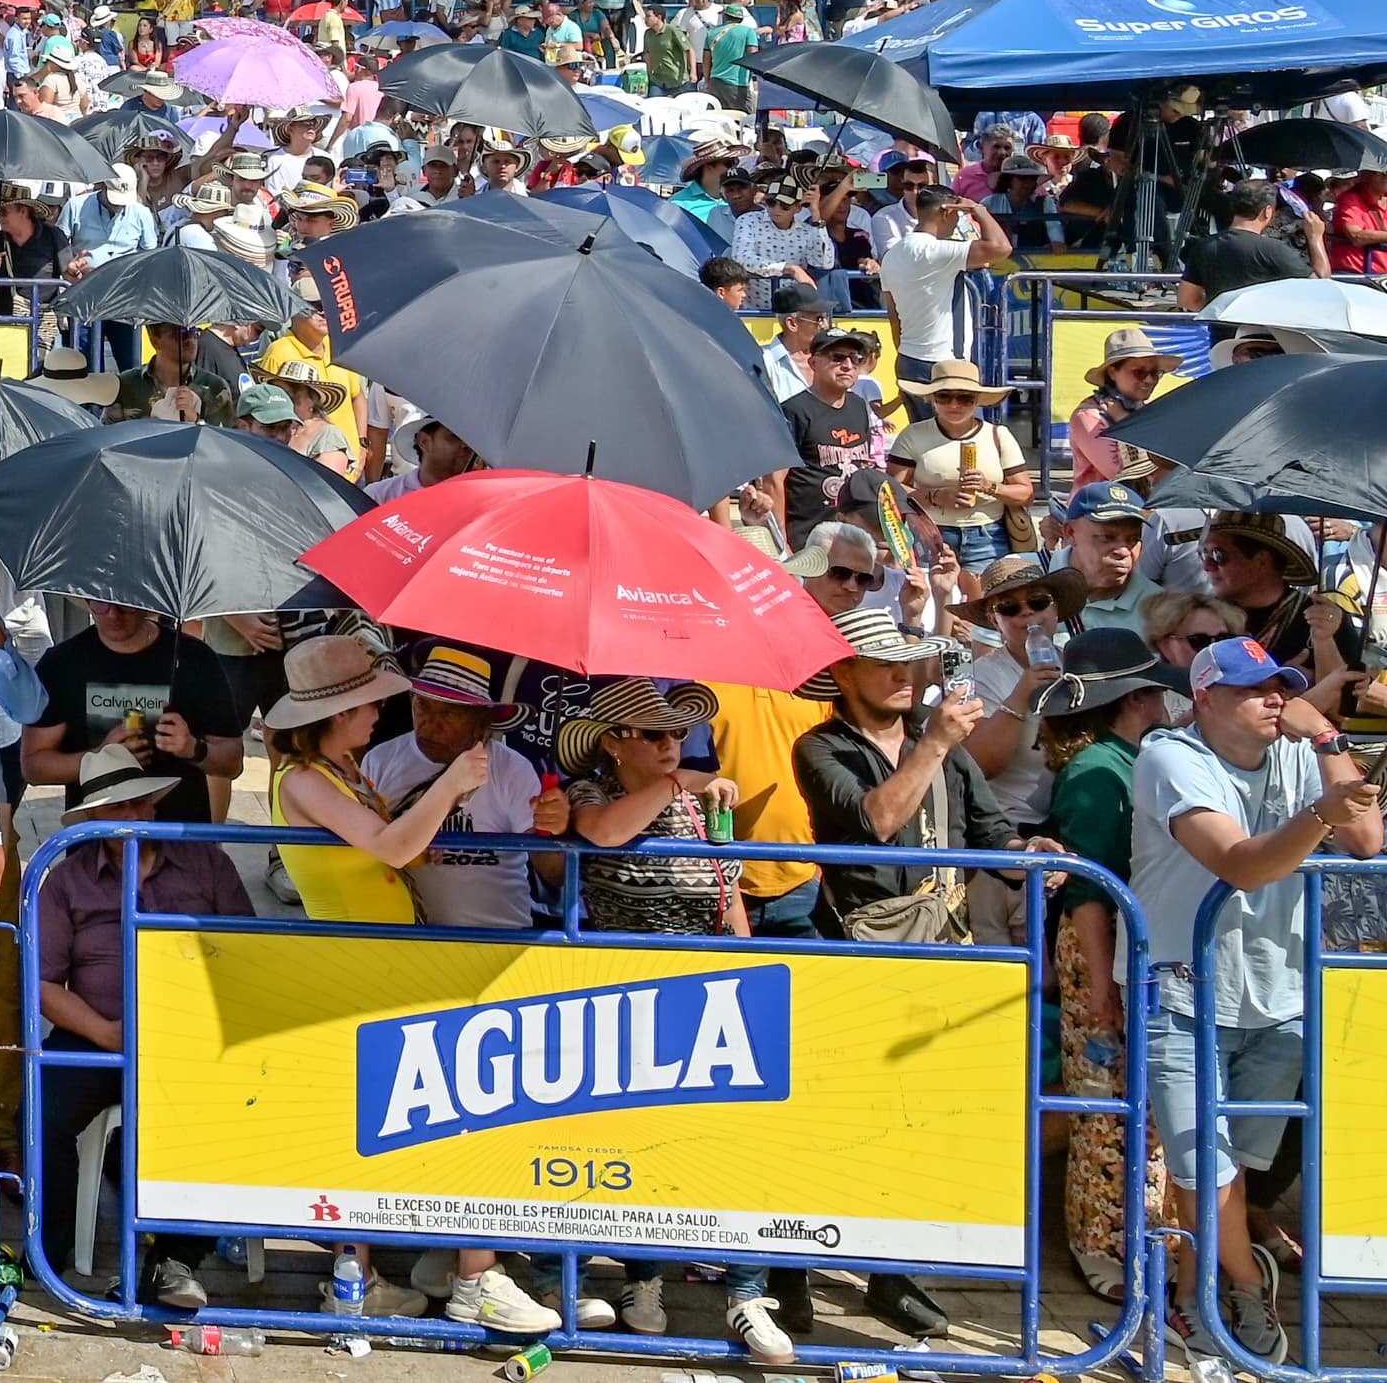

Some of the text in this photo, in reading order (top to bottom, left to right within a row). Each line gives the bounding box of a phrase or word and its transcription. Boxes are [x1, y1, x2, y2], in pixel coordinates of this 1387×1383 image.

[330, 270, 358, 334] TRUPER
[381, 514, 423, 544] Avianca
[617, 584, 694, 605] Avianca
[91, 694, 133, 709] Calvin
[442, 854, 500, 866] 2025
[377, 978, 766, 1138] AGUILA
[538, 1144, 624, 1154] FAMOSA DESDE
[529, 1157, 632, 1190] 1913
[377, 1198, 720, 1227] EL EXCESO DE ALCOHOL ES PERJUDICIAL PARA LA SALUD.
[773, 1219, 805, 1230] VIVE
[349, 1211, 749, 1244] PROHÍBESE EL EXPENDIO DE BEBIDAS EMBRIAGANTES A MENORES DE EDAD.
